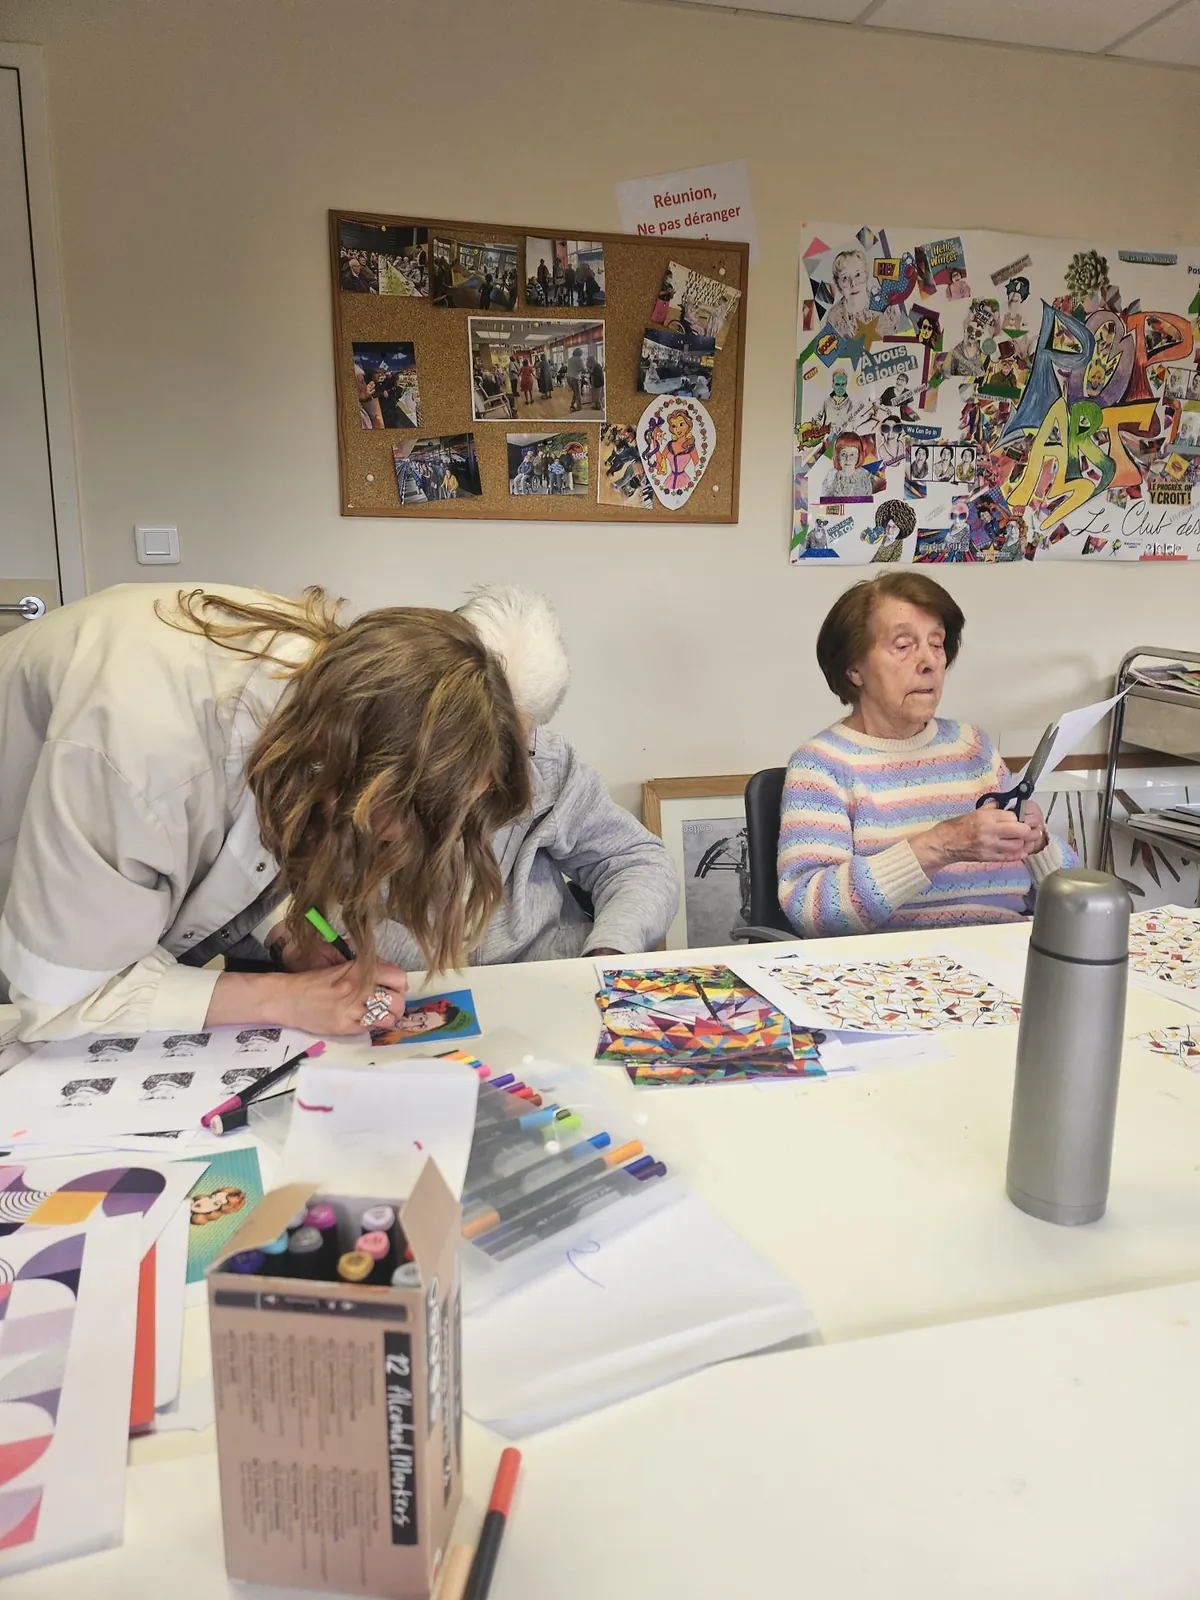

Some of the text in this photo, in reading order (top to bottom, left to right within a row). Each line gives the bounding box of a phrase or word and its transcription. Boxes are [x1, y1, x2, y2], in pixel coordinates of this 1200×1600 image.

[653, 187, 717, 209] Réunion,
[637, 206, 741, 236] Ne pas déranger
[874, 346, 907, 364] vous
[857, 371, 875, 386] de
[1071, 508, 1111, 537] Le
[1122, 500, 1172, 536] Club
[385, 1353, 416, 1528] 12 Alcohol Markers
